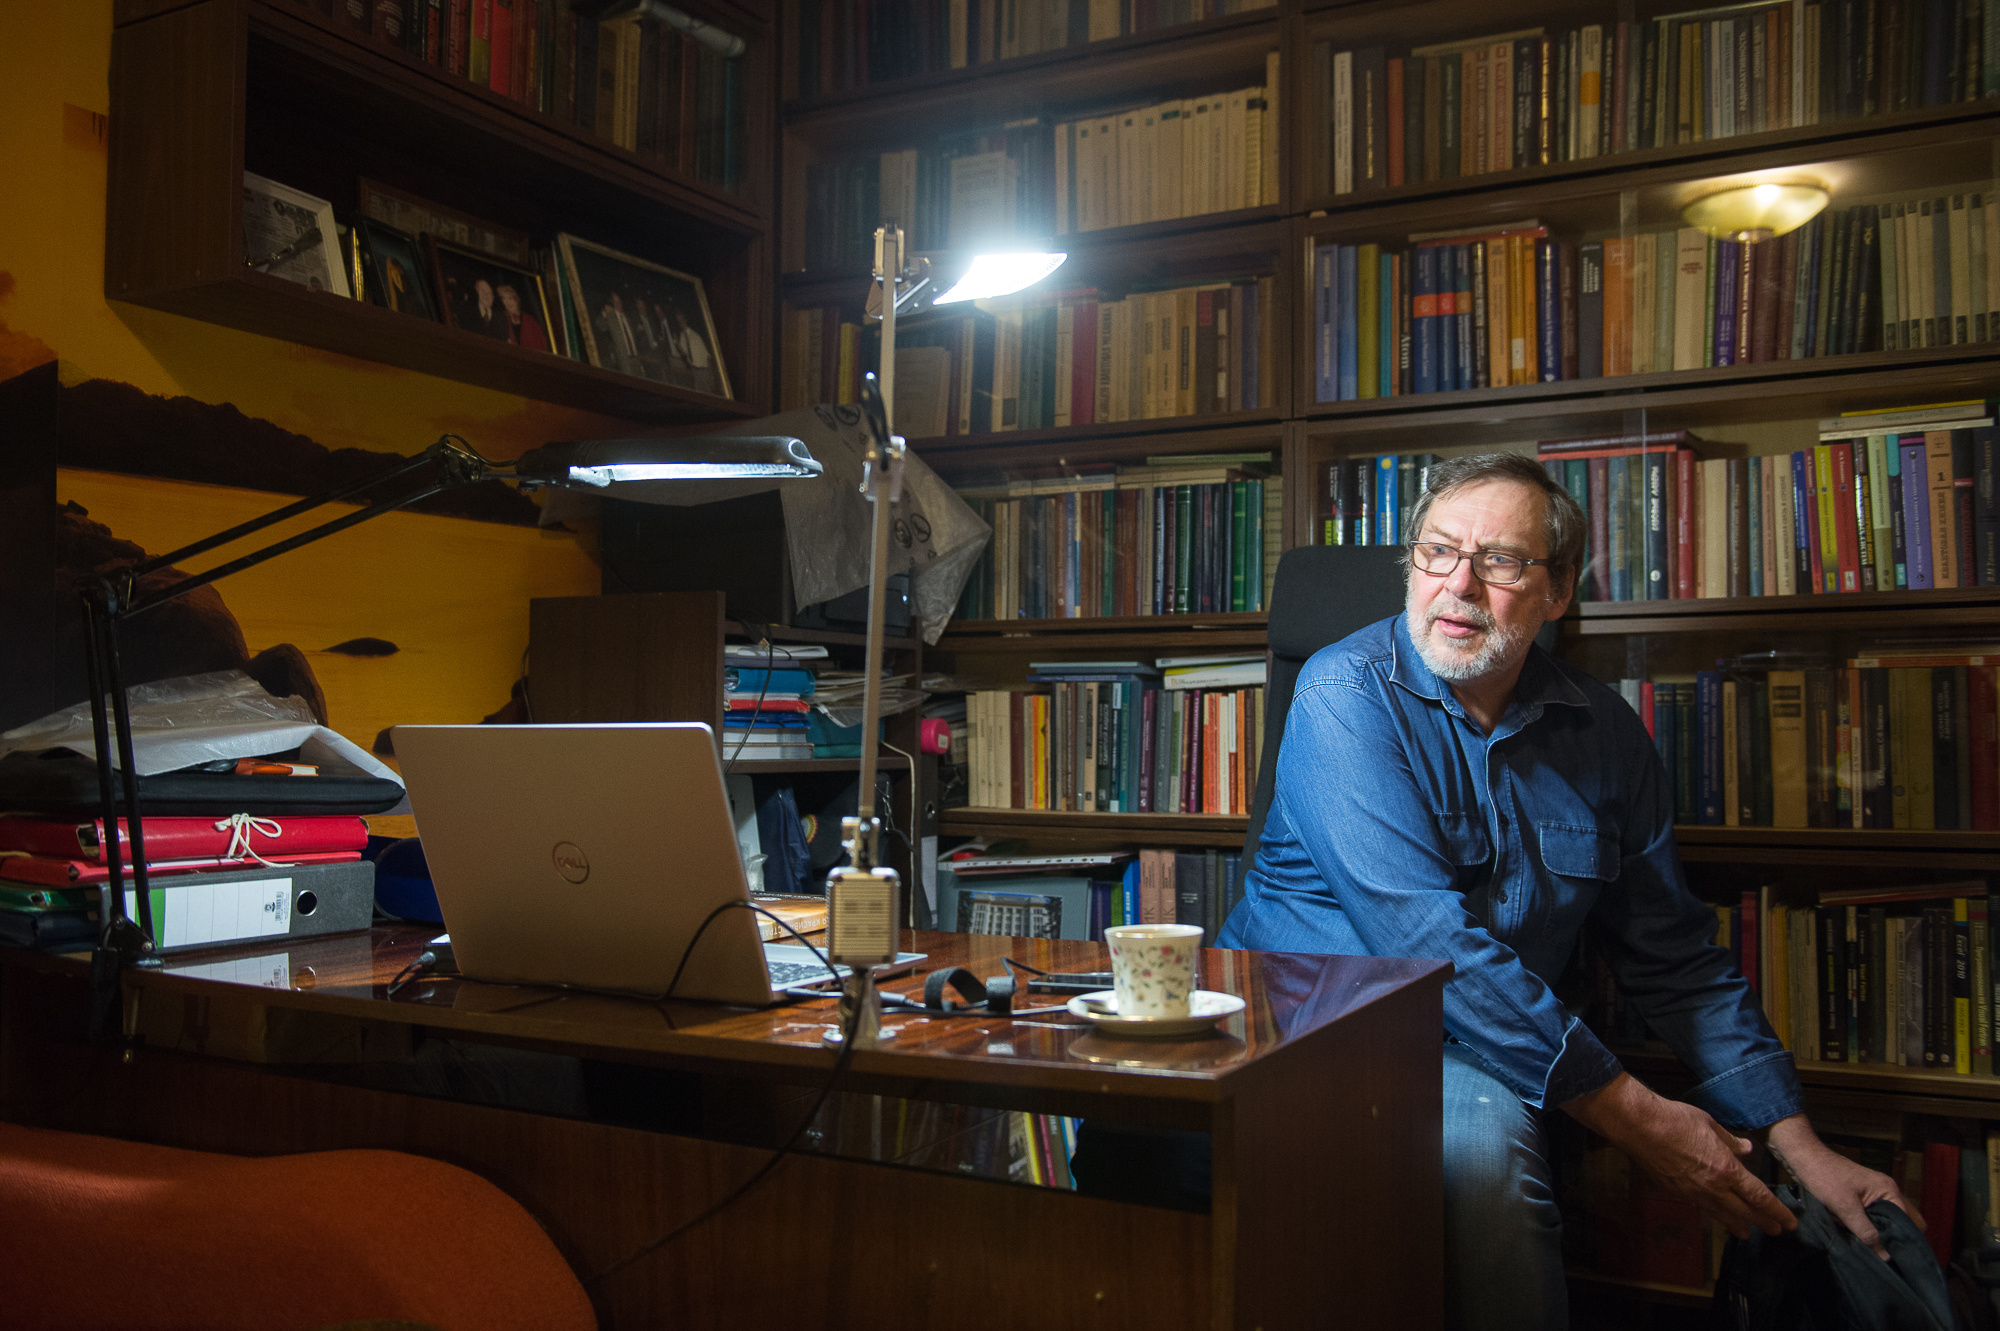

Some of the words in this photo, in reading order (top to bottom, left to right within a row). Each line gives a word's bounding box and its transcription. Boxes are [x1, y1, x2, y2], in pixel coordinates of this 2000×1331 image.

[1739, 31, 1747, 111] РАДИОАКТИВНОСТЬ
[1400, 335, 1411, 369] Atom
[1940, 527, 1950, 578] КВАНТОВАЯ
[557, 857, 587, 870] DELL
[760, 925, 783, 937] СТРАН
[1956, 934, 1966, 956] Excel
[1956, 960, 1965, 979] 2010
[1978, 1005, 1987, 1023] Visual
[1979, 1024, 1987, 1046] Fortran
